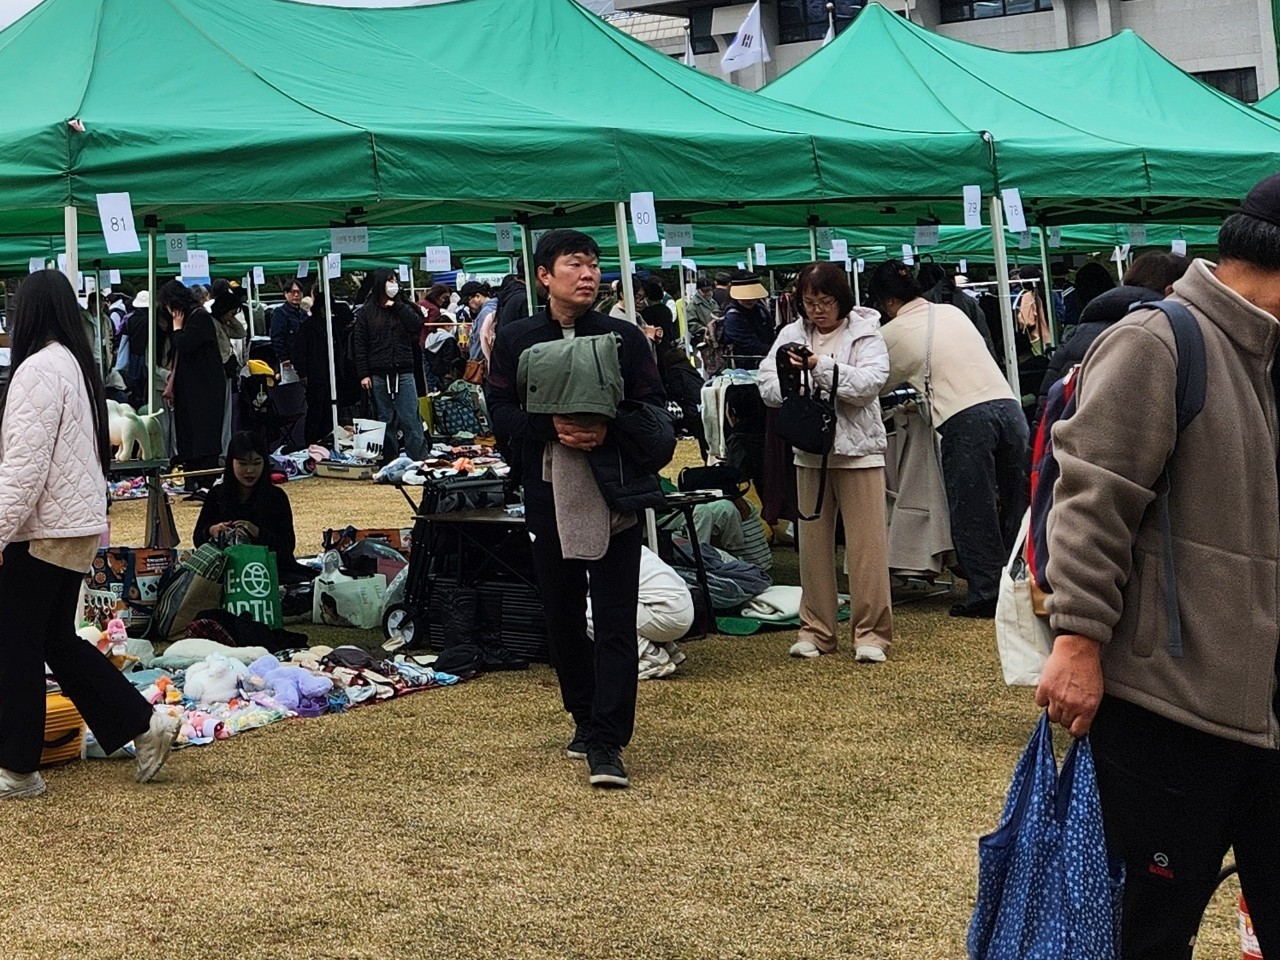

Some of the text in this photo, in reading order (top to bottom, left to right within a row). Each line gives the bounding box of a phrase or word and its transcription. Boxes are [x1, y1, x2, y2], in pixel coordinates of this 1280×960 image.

[967, 201, 977, 214] 79
[110, 216, 127, 232] 81
[635, 211, 650, 225] 80
